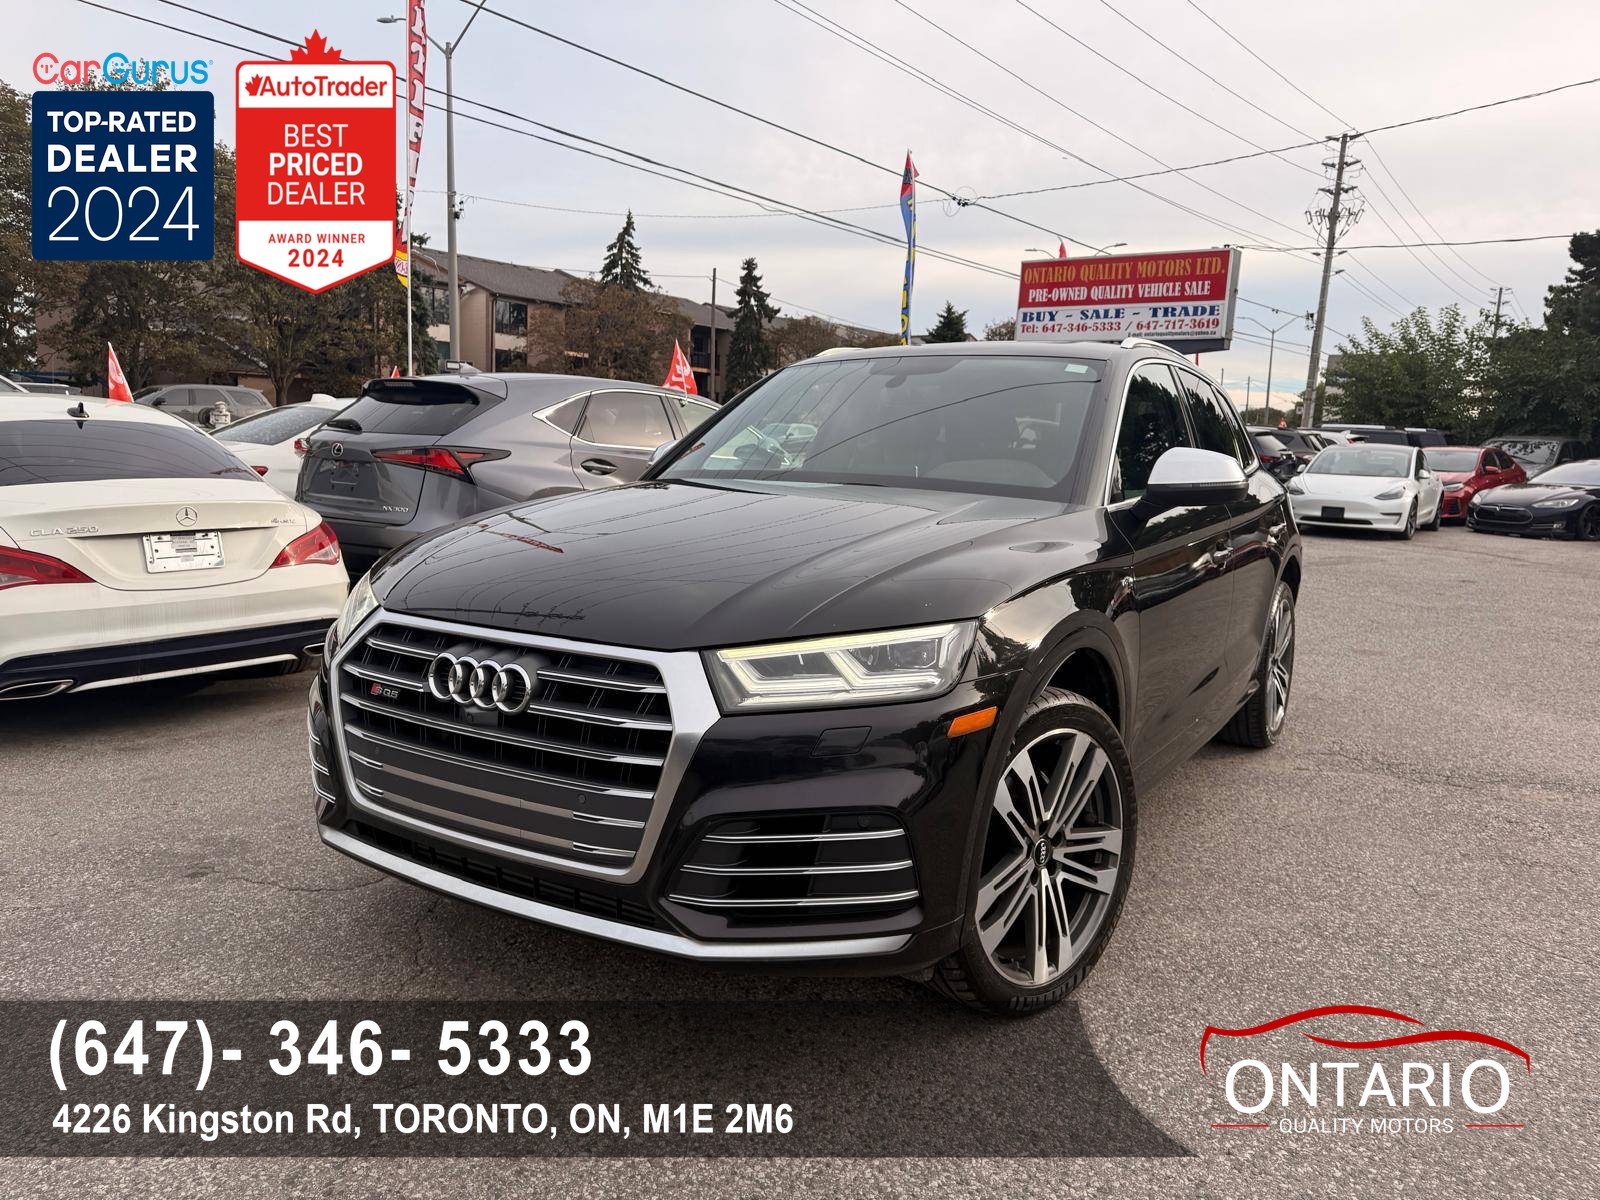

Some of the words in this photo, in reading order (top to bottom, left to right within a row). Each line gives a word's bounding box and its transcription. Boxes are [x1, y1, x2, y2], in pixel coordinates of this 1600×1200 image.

[1024, 265, 1076, 284] ONTARIO
[1080, 262, 1133, 283] QUALITY
[1136, 258, 1191, 278] MOTORS
[1196, 256, 1225, 275] LTD.
[1028, 286, 1088, 303] PRE-OWNED
[1090, 284, 1135, 301] QUALITY
[1138, 281, 1182, 298] VEHICLE
[1184, 280, 1211, 296] SALE
[1021, 311, 1058, 322] BUY
[1080, 308, 1125, 320] SALE
[1149, 305, 1220, 318] TRADE
[1021, 324, 1039, 334] Tel:
[1042, 321, 1121, 333] 647-346-5333
[1136, 318, 1220, 331] 647-717-3619
[30, 528, 63, 537] CLA
[66, 526, 99, 535] 250
